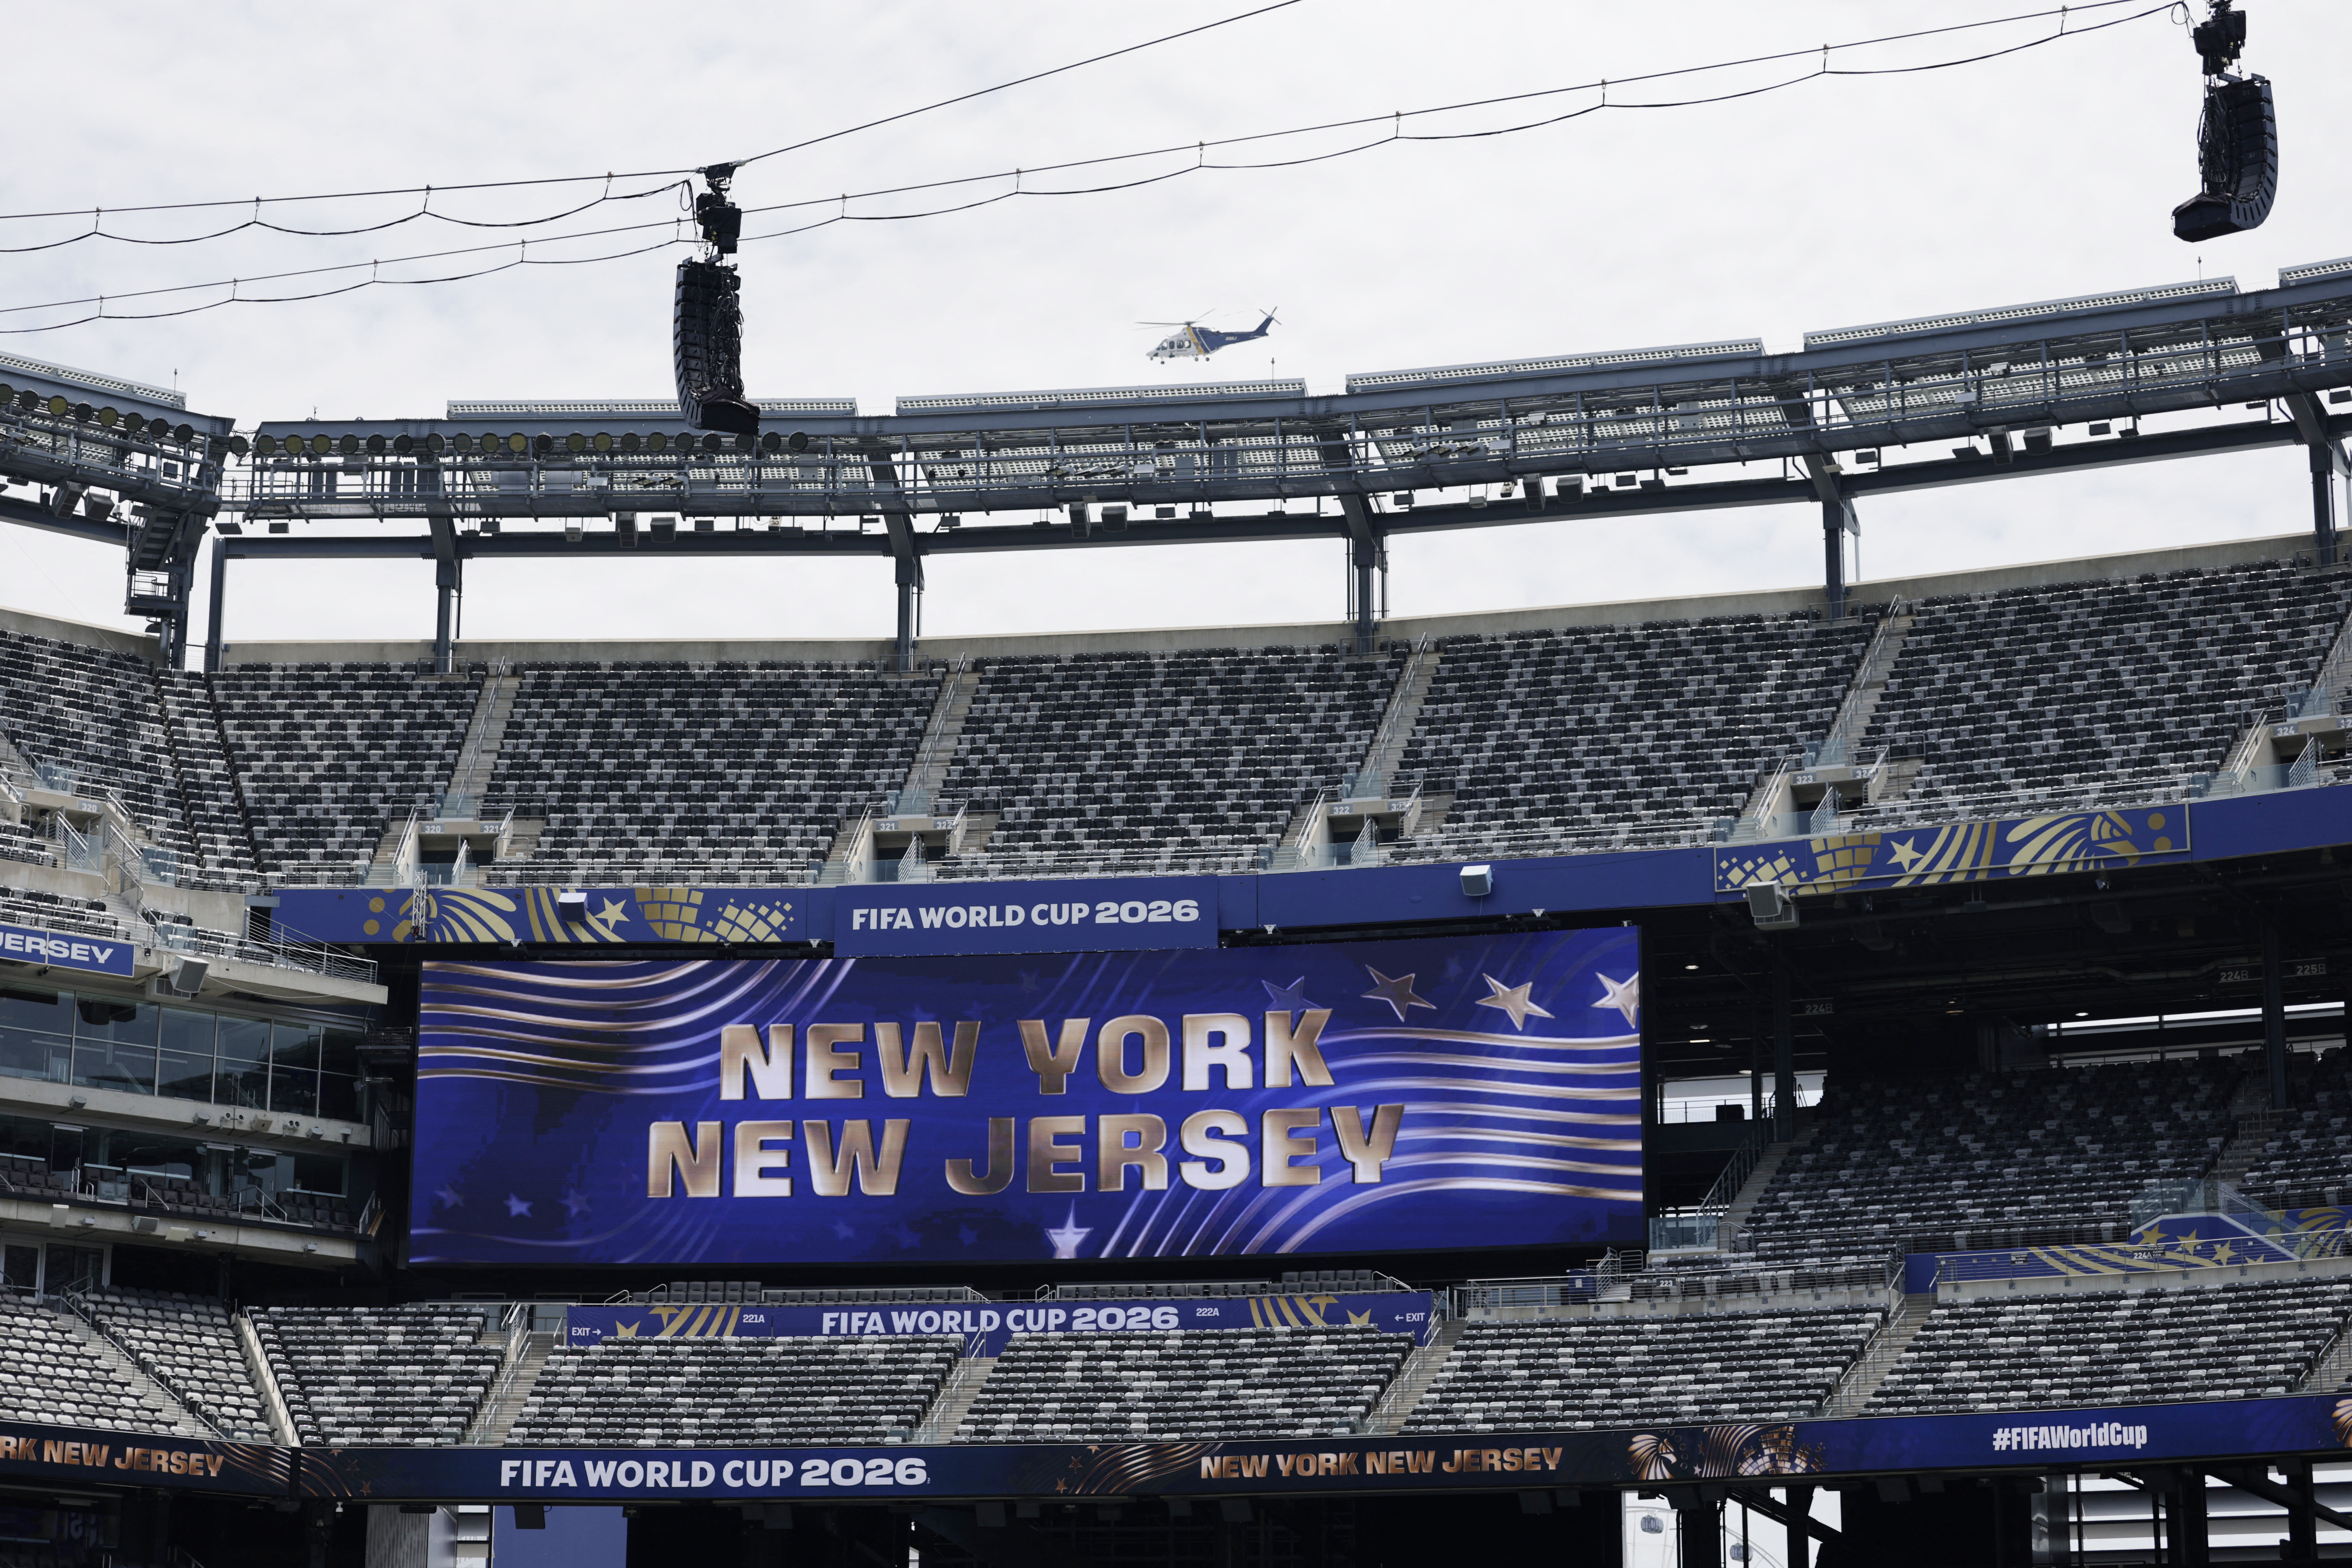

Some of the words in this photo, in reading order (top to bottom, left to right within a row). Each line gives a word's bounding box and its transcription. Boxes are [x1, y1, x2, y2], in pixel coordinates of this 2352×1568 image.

[2277, 726, 2295, 736] 324
[1797, 775, 1813, 784] 323
[82, 803, 97, 812] 320
[1334, 806, 1349, 815] 322
[1391, 803, 1408, 811] 323
[425, 825, 441, 833] 320
[880, 823, 895, 831] 321
[937, 821, 953, 829] 322
[853, 908, 914, 930] FIFA
[919, 905, 1024, 928] WORLD
[1031, 903, 1090, 925] CUP
[1095, 899, 1199, 923] 2026
[0, 931, 114, 964] ERSEY
[2296, 964, 2326, 975] 225B
[2220, 970, 2249, 982] 224B
[1806, 1003, 1833, 1014] 224B
[719, 1020, 981, 1100] NEW
[1017, 1008, 1335, 1095] YORK
[647, 1119, 910, 1198] NEW
[945, 1104, 1405, 1195] JERSEY
[1196, 1307, 1219, 1316] 222A
[743, 1314, 765, 1323] 221A
[823, 1312, 886, 1334] FIFA
[891, 1310, 1000, 1333] WORLD
[1006, 1309, 1066, 1332] CUP
[1072, 1306, 1179, 1330] 2026
[1406, 1312, 1425, 1322] EXIT
[572, 1328, 590, 1336] EXIT
[1993, 1422, 2147, 1451] #FIFAWorldCup
[44, 1440, 109, 1467] NEW
[114, 1447, 224, 1477] JERSEY
[1201, 1454, 1269, 1479] NEW
[1276, 1452, 1359, 1477] YORK
[1366, 1450, 1435, 1474] NEW
[1442, 1447, 1563, 1473] JERSEY
[501, 1460, 577, 1487] FIFA
[584, 1460, 715, 1488] WORLD
[723, 1460, 793, 1487] CUP
[800, 1458, 927, 1486] 2026
